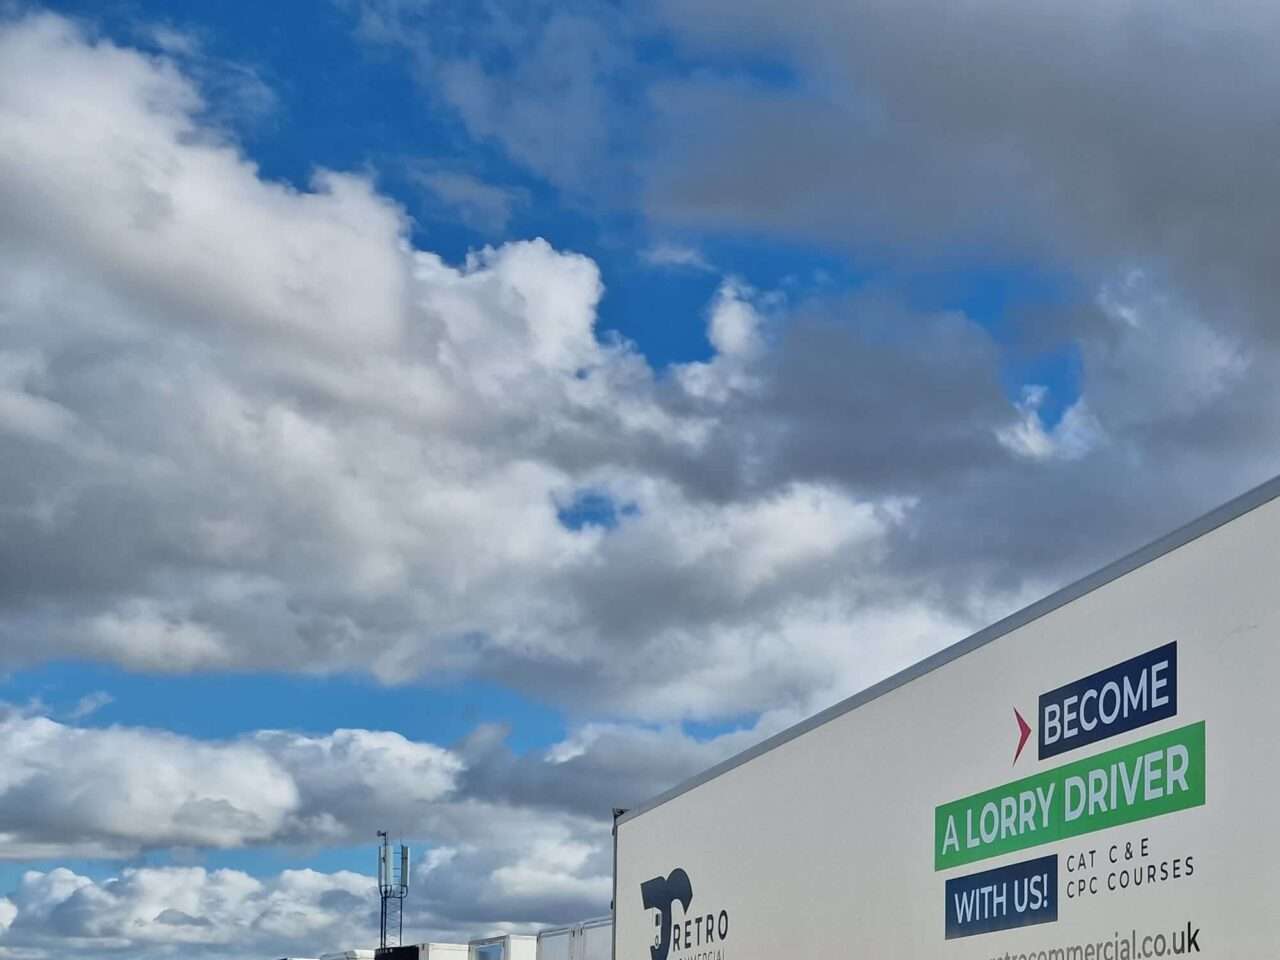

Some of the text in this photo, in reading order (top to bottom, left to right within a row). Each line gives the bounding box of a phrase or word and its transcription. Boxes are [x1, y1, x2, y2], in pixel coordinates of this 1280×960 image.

[1044, 660, 1169, 745] BECOME
[942, 744, 1189, 855] A LORRY DRIVER
[1066, 837, 1149, 873] CAT C & E
[1066, 856, 1195, 899] CPC COURSES
[954, 873, 1048, 924] WITH US!
[673, 909, 728, 952] RETRO
